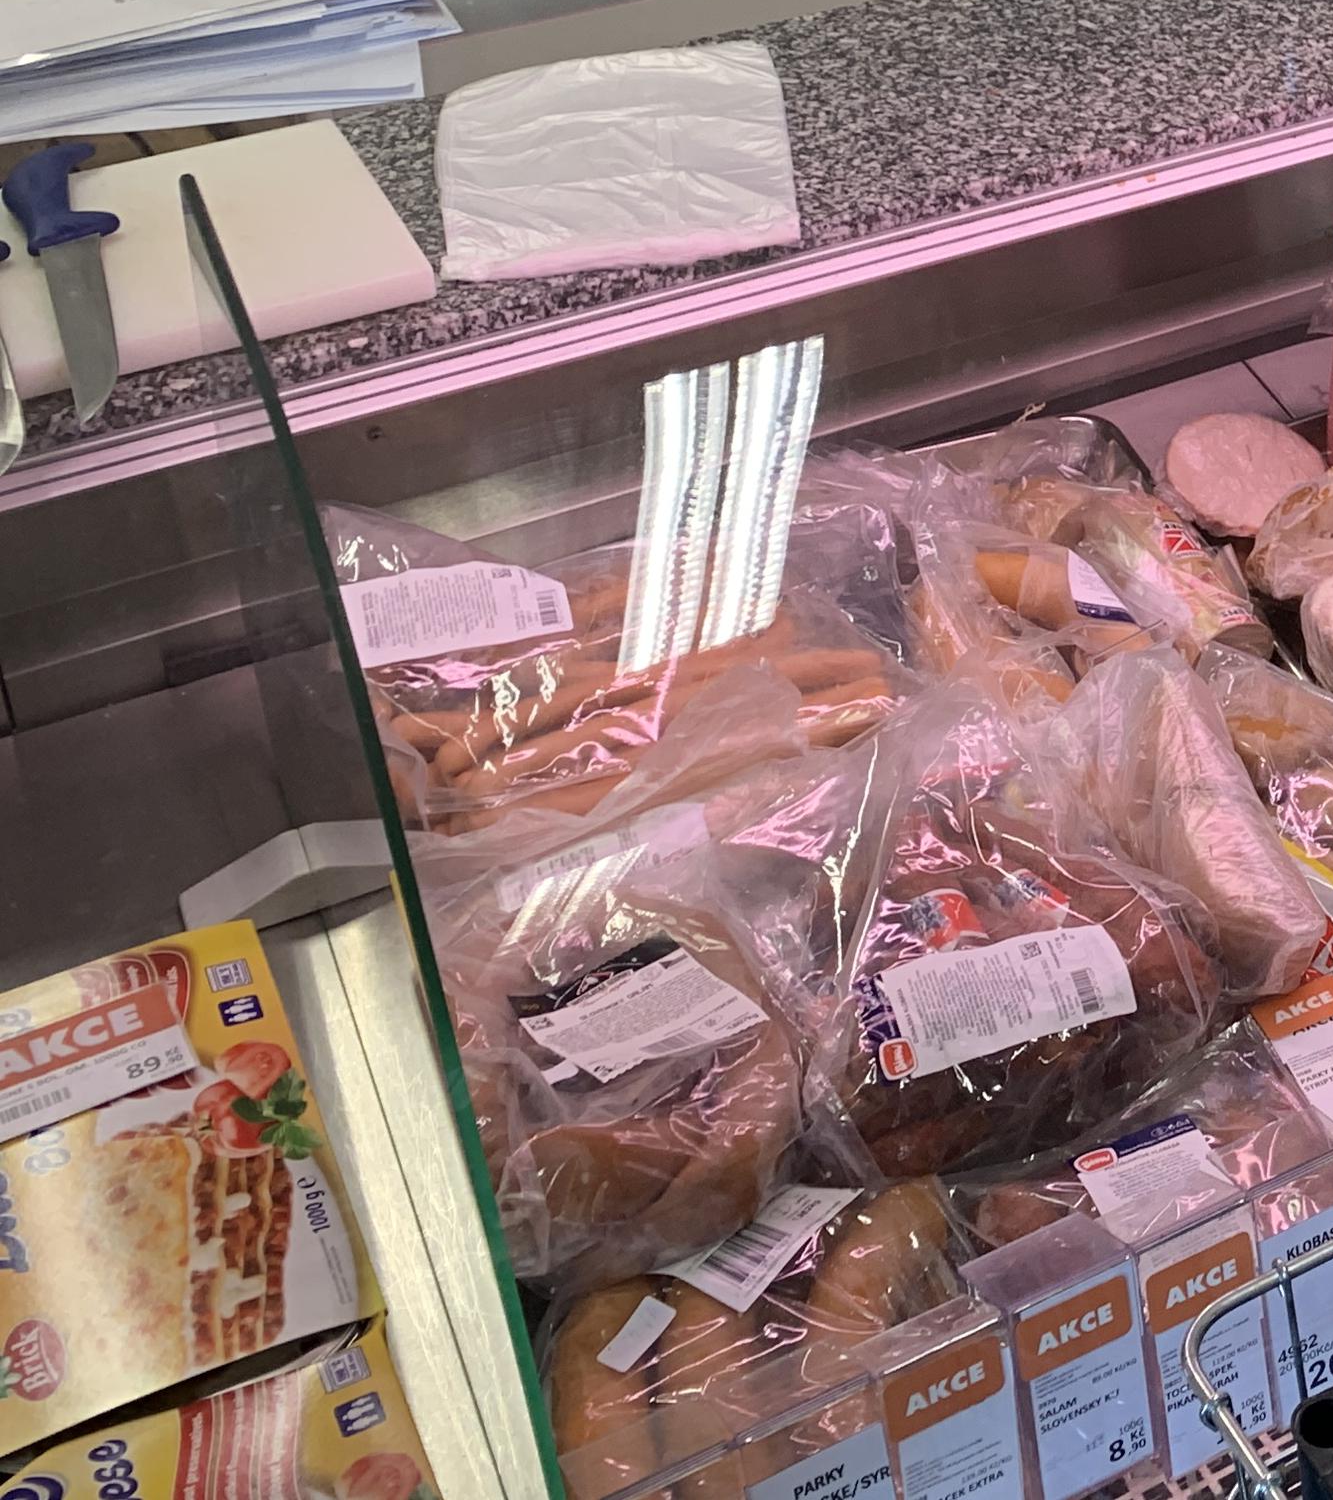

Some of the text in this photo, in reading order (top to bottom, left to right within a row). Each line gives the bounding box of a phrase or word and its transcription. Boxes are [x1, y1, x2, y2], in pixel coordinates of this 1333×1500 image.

[0, 1003, 144, 1079] AKCE
[126, 1056, 161, 1079] 89
[1166, 1258, 1238, 1310] AKCE
[1036, 1302, 1114, 1356] AKCE
[22, 1331, 53, 1393] Brick
[906, 1360, 986, 1418] AKCE
[1039, 1396, 1077, 1422] SALAM
[1109, 1439, 1126, 1462] 8
[793, 1463, 845, 1500] PARKY
